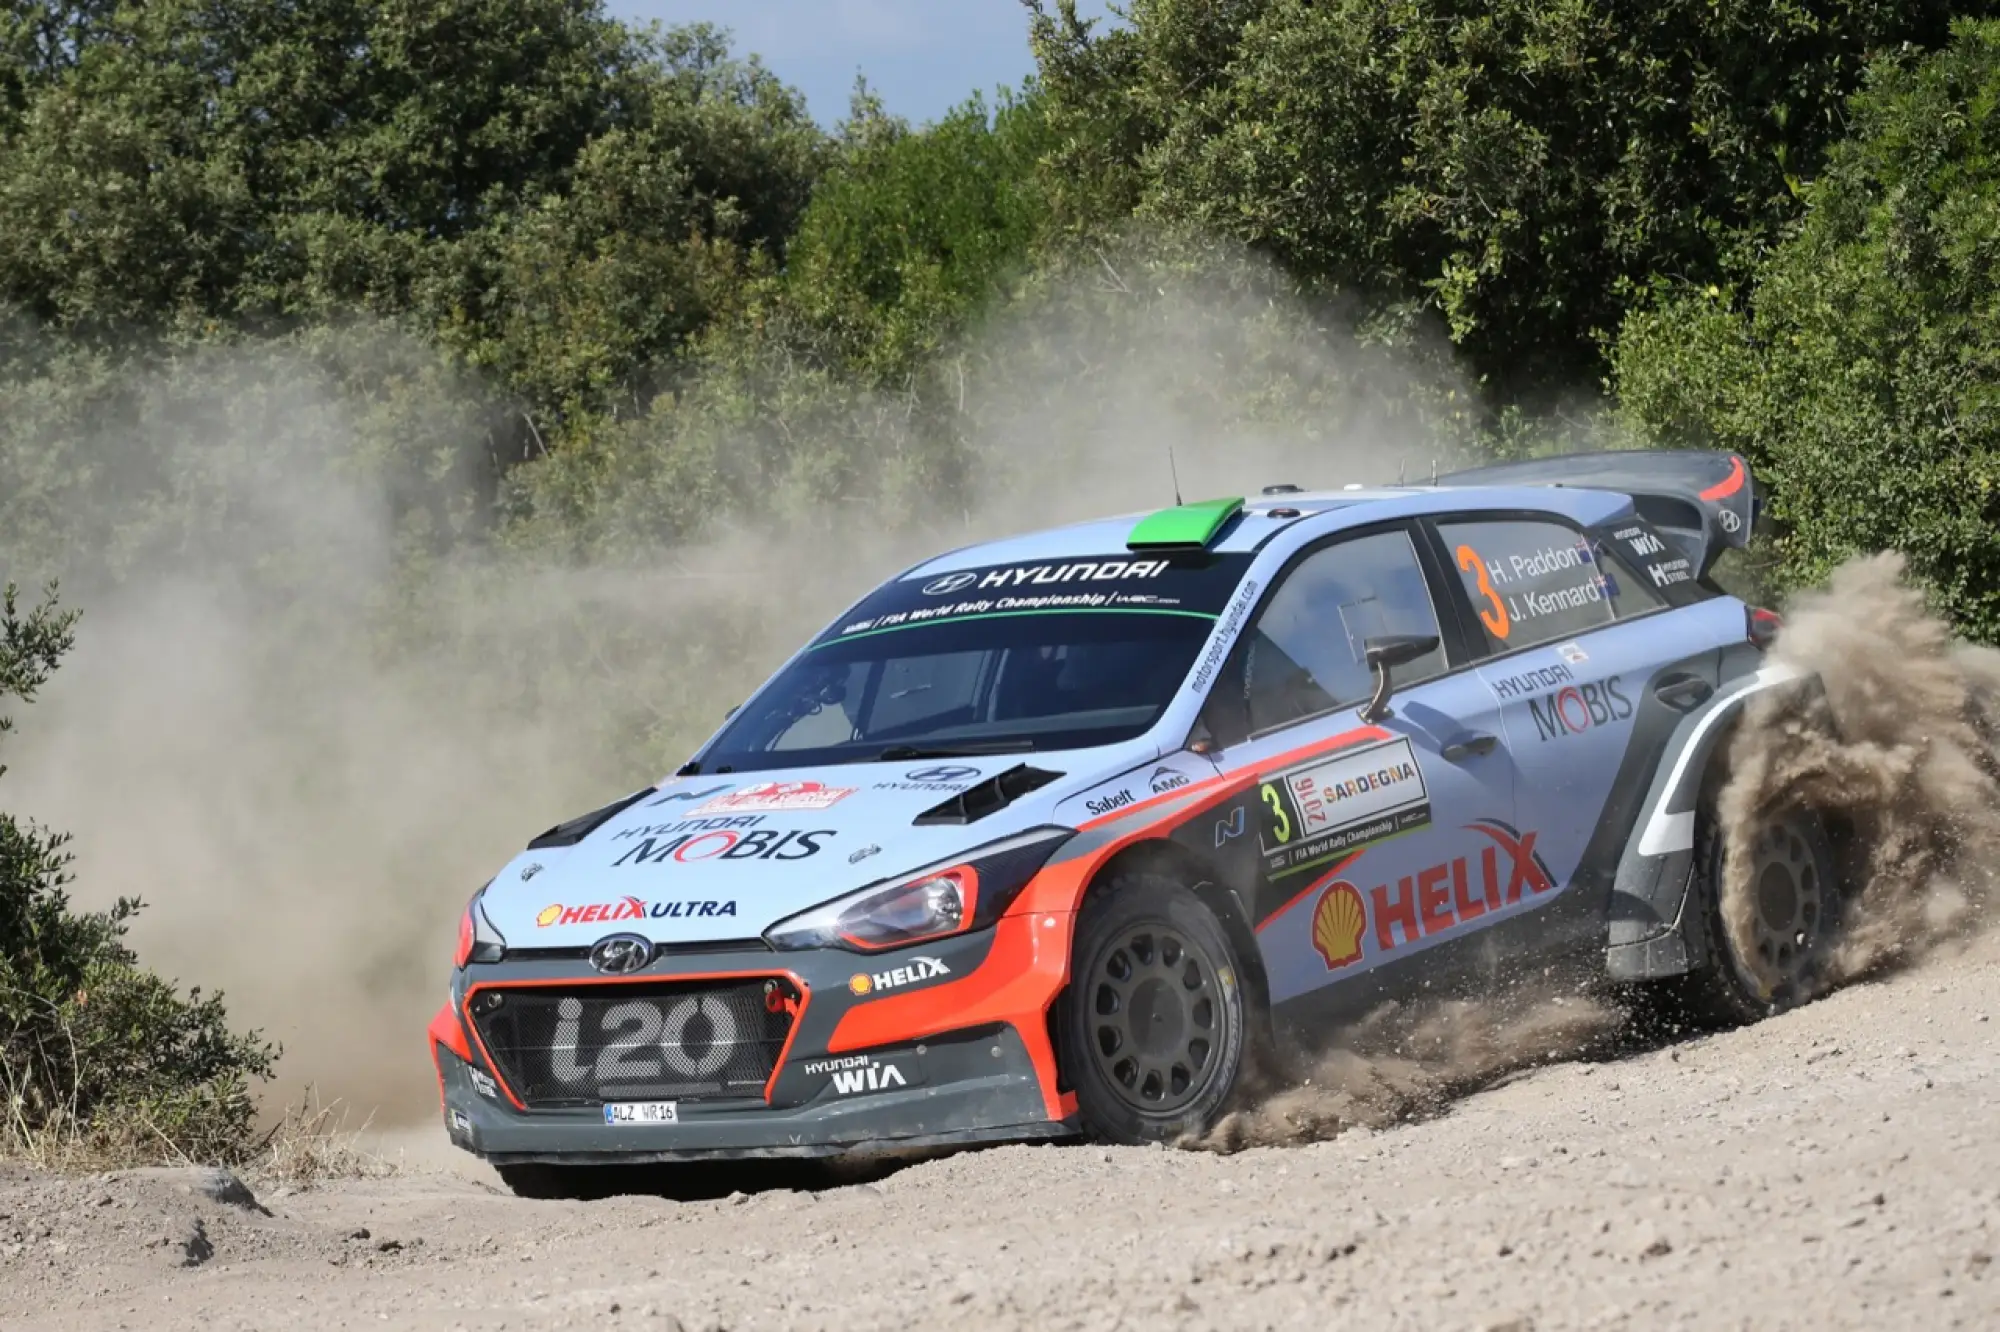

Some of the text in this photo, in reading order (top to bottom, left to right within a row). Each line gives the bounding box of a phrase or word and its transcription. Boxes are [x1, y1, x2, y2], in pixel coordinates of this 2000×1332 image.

[977, 560, 1170, 589] HYUNDAI
[1486, 547, 1582, 584] H. Paddon
[909, 603, 955, 621] World
[954, 600, 995, 615] Rally
[995, 592, 1107, 609] Championship
[1456, 545, 1510, 639] 3
[1508, 575, 1601, 622] J. Kennard
[1191, 580, 1258, 693] motorsport.hyundai.com
[1491, 664, 1574, 698] HYUNDAI
[1528, 675, 1633, 741] MOBIS
[1323, 762, 1415, 804] SARDEGNA
[1085, 788, 1136, 816] Sabelt
[1261, 783, 1290, 844] 3
[1294, 777, 1327, 827] 2016
[611, 815, 767, 841] HYUNDAI
[1307, 841, 1328, 857] World
[1329, 836, 1346, 850] Rally
[1346, 822, 1393, 846] Championship
[610, 830, 838, 867] MOBIS
[1370, 825, 1557, 951] HELIX
[559, 895, 736, 926] HELIX ULTRA
[872, 956, 950, 991] HELIX
[551, 996, 737, 1086] i20
[804, 1054, 868, 1075] HYUNDAI
